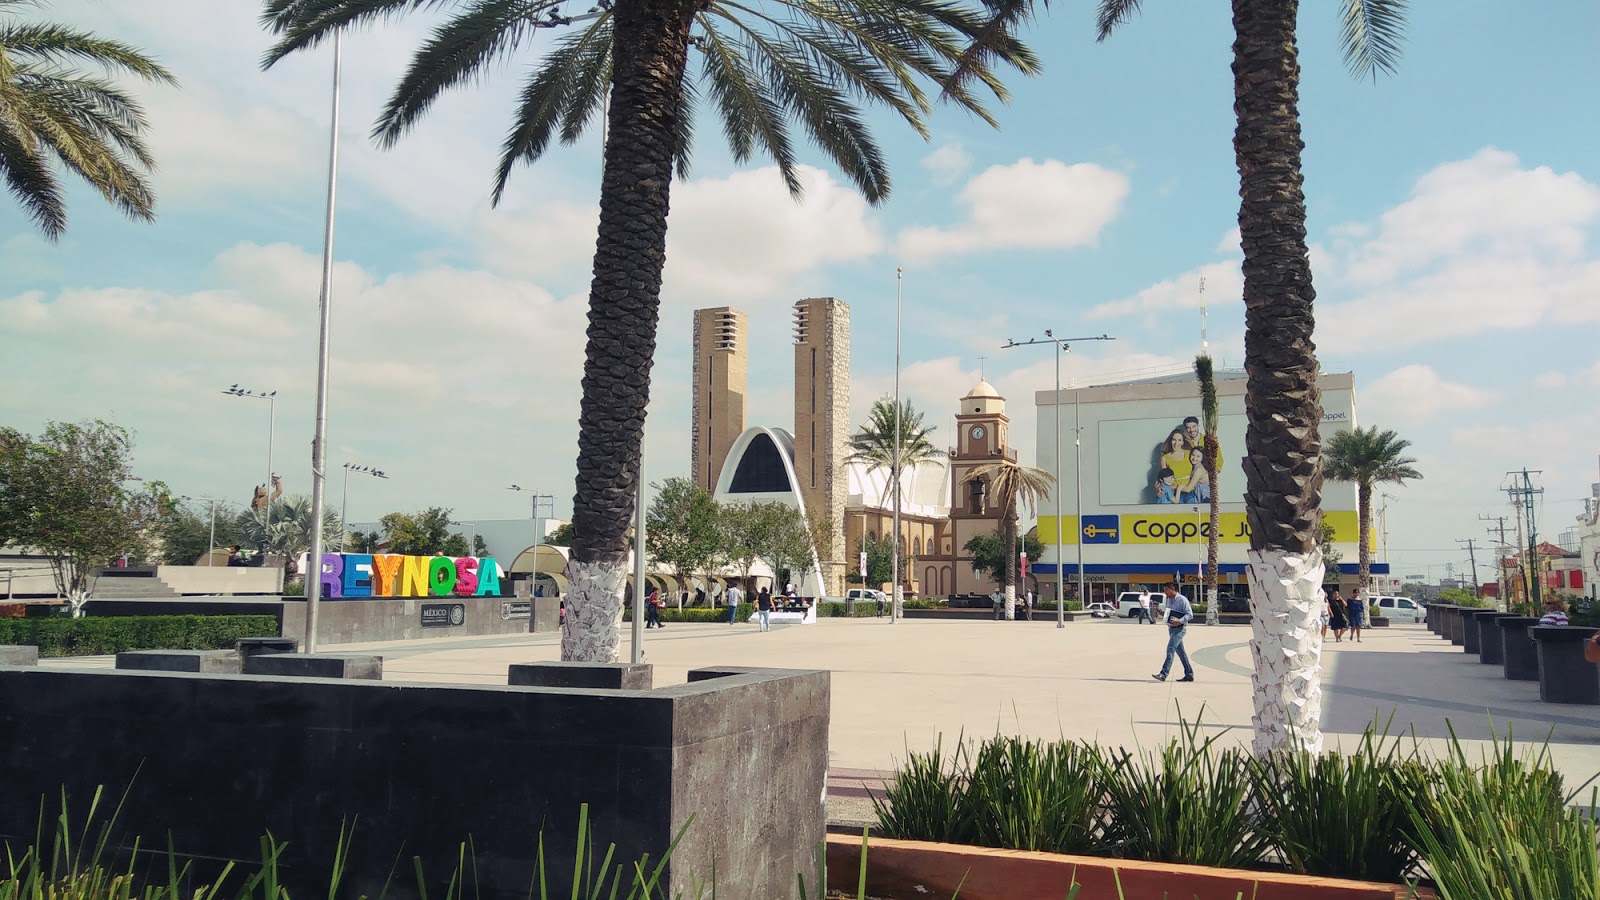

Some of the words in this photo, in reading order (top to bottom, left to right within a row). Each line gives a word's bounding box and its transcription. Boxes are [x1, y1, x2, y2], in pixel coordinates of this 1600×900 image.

[1321, 411, 1347, 421] oppel
[1133, 519, 1224, 543] Coppe
[317, 554, 501, 598] REYNOSA
[1069, 574, 1107, 583] BaCoppel
[423, 608, 447, 617] MÉXICO
